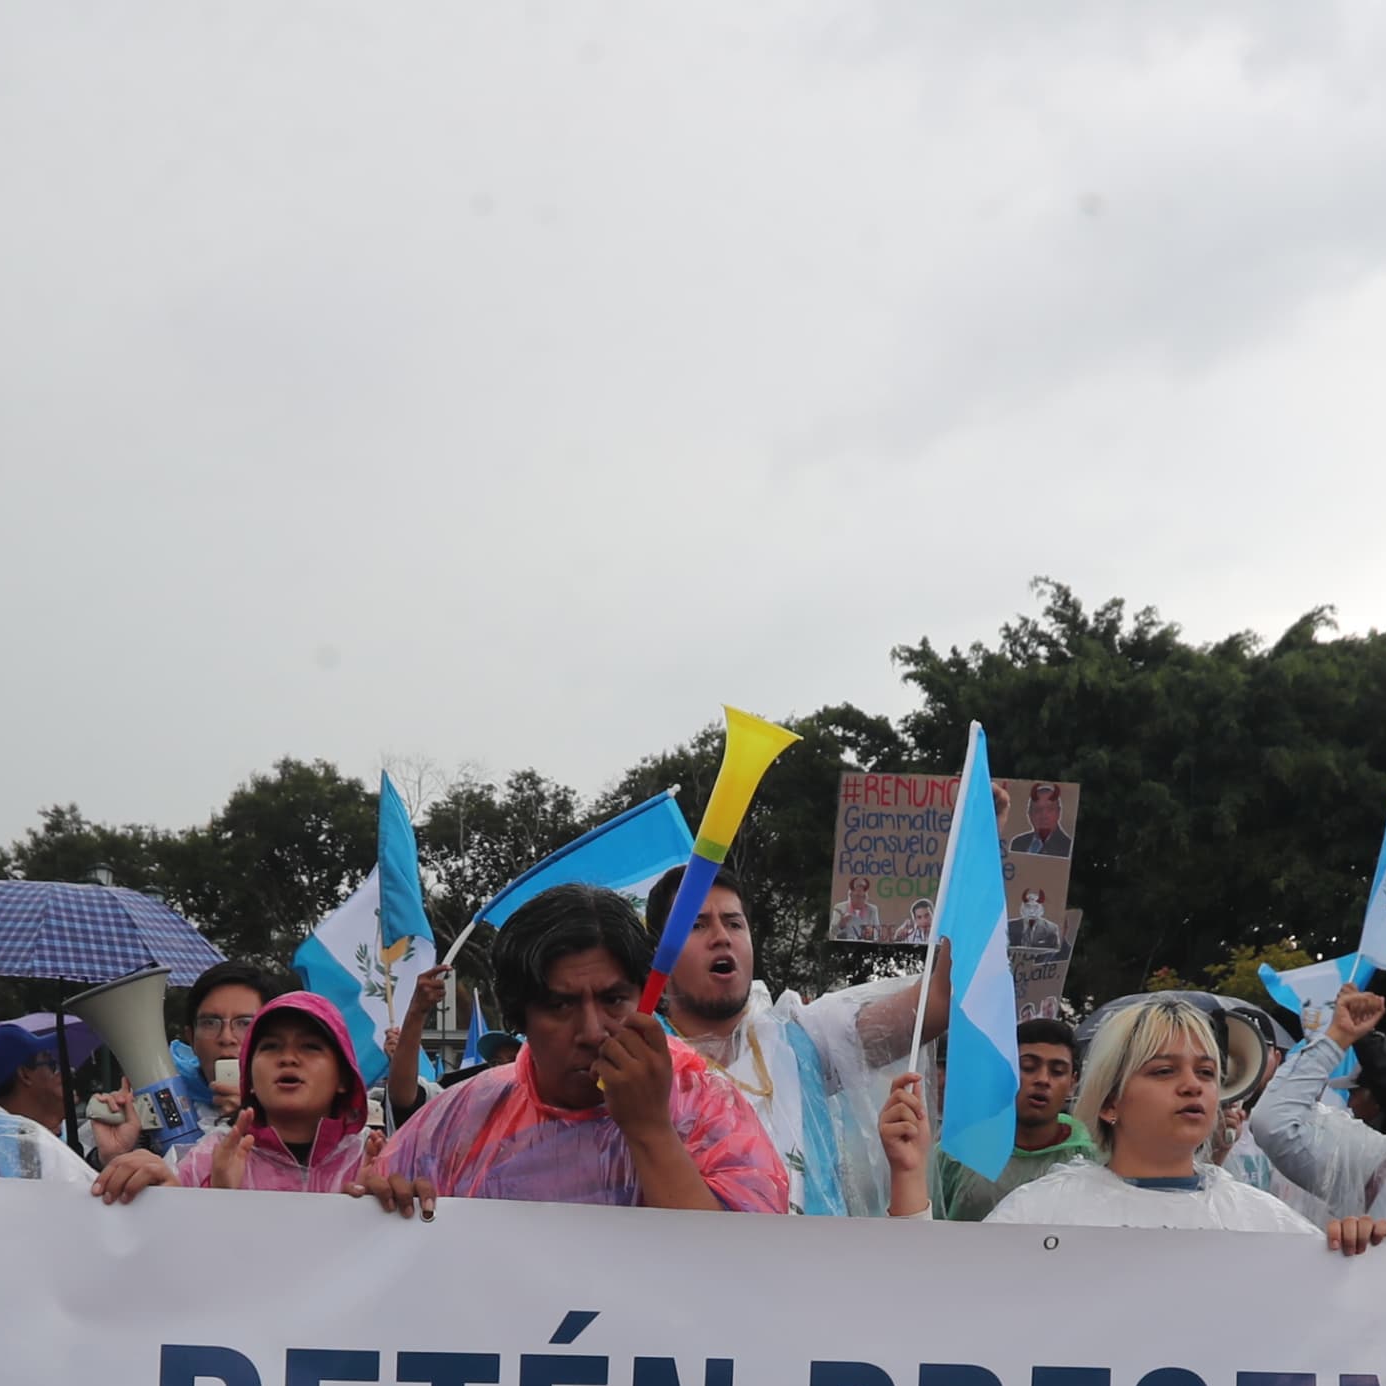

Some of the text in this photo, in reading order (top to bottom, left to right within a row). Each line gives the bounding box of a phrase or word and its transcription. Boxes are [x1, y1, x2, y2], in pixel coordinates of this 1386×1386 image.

[844, 805, 954, 833] Giammatte
[844, 828, 938, 856] Consuelo
[839, 851, 898, 877] Rafael
